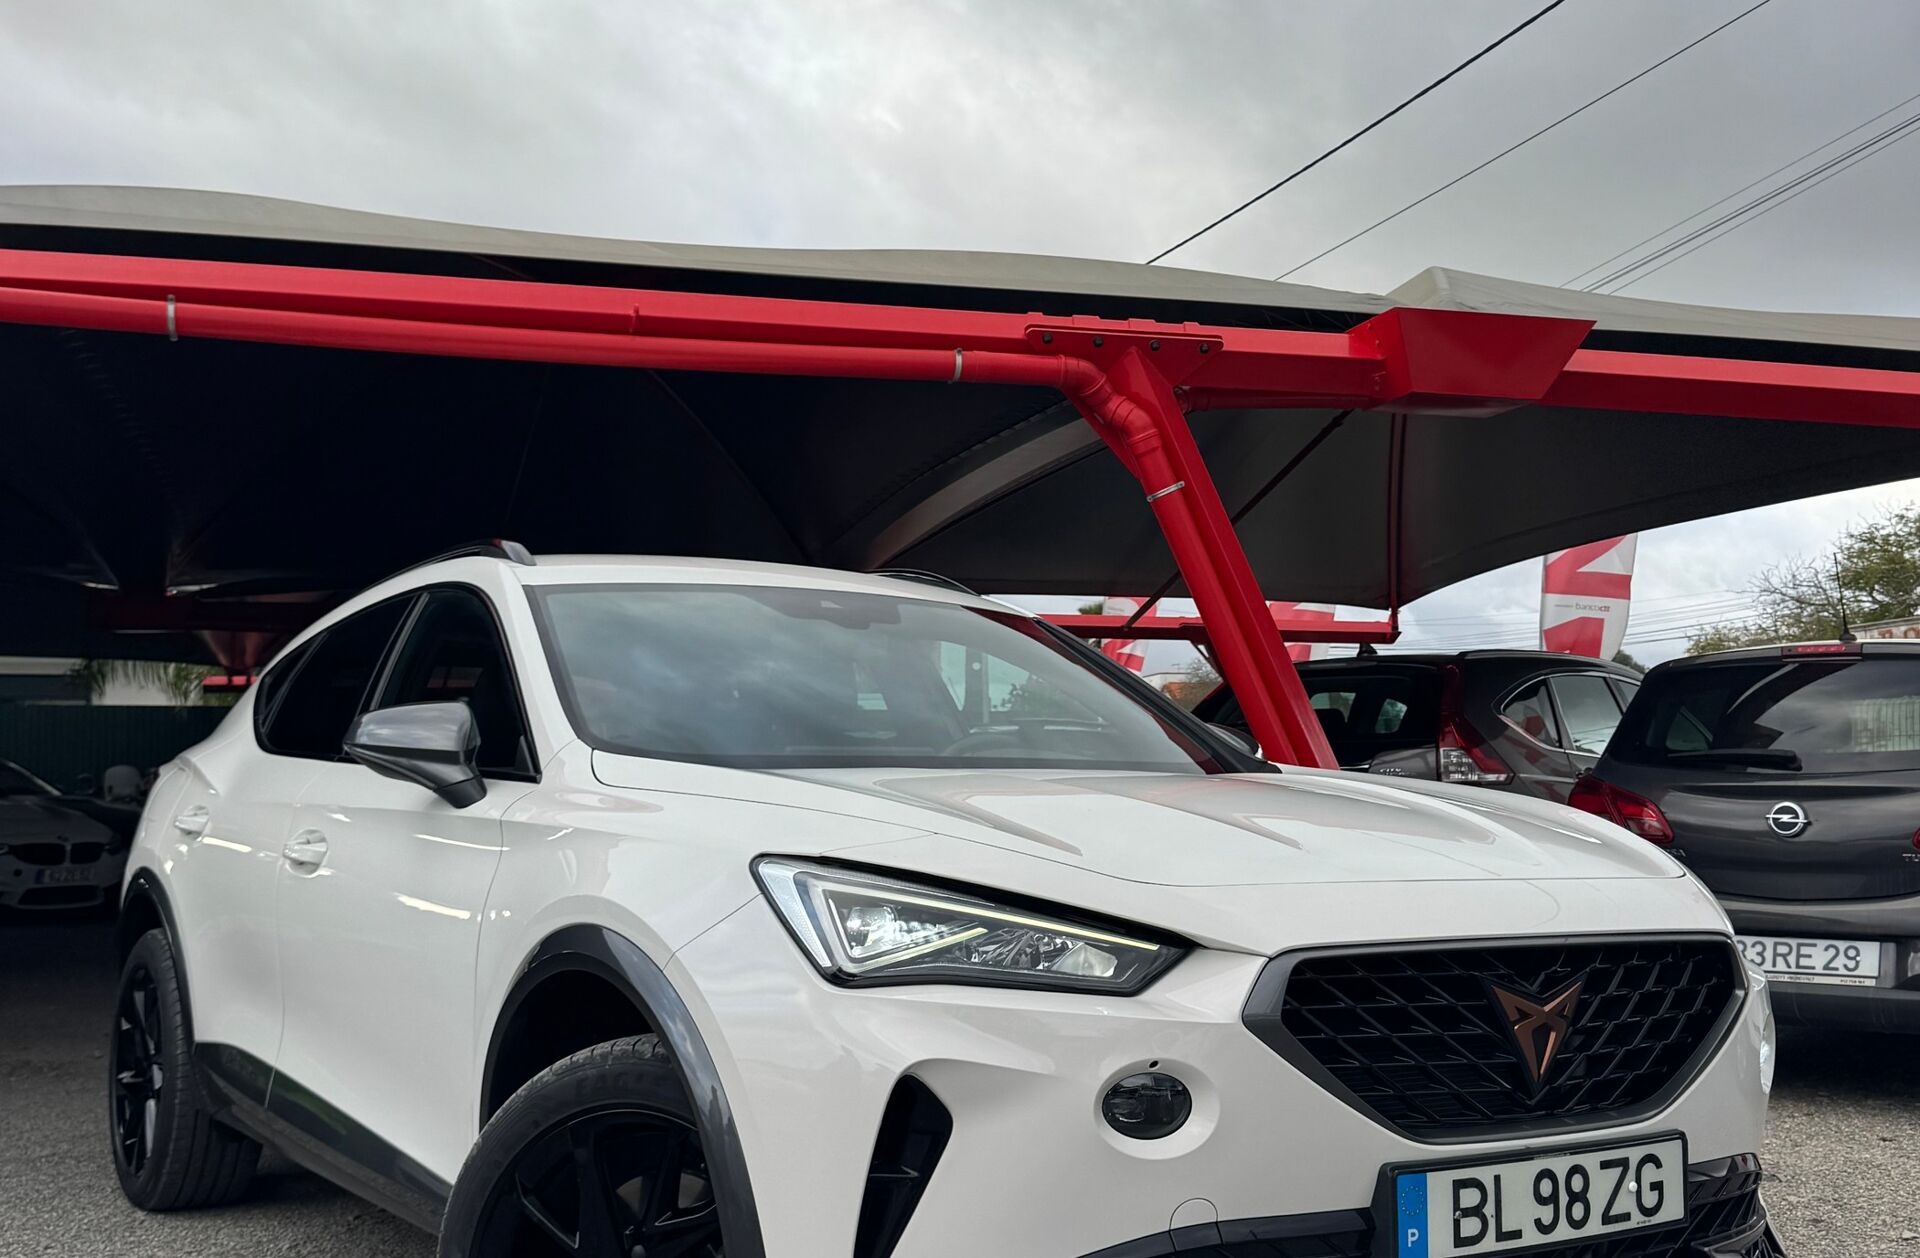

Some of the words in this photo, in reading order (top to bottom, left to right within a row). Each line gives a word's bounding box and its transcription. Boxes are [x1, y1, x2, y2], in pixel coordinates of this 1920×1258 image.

[1772, 941, 1818, 969] RE
[1822, 944, 1861, 972] 29
[1452, 1174, 1523, 1249] BL
[1533, 1164, 1591, 1236] 98
[1600, 1153, 1664, 1226] ZG
[1407, 1228, 1419, 1248] P
